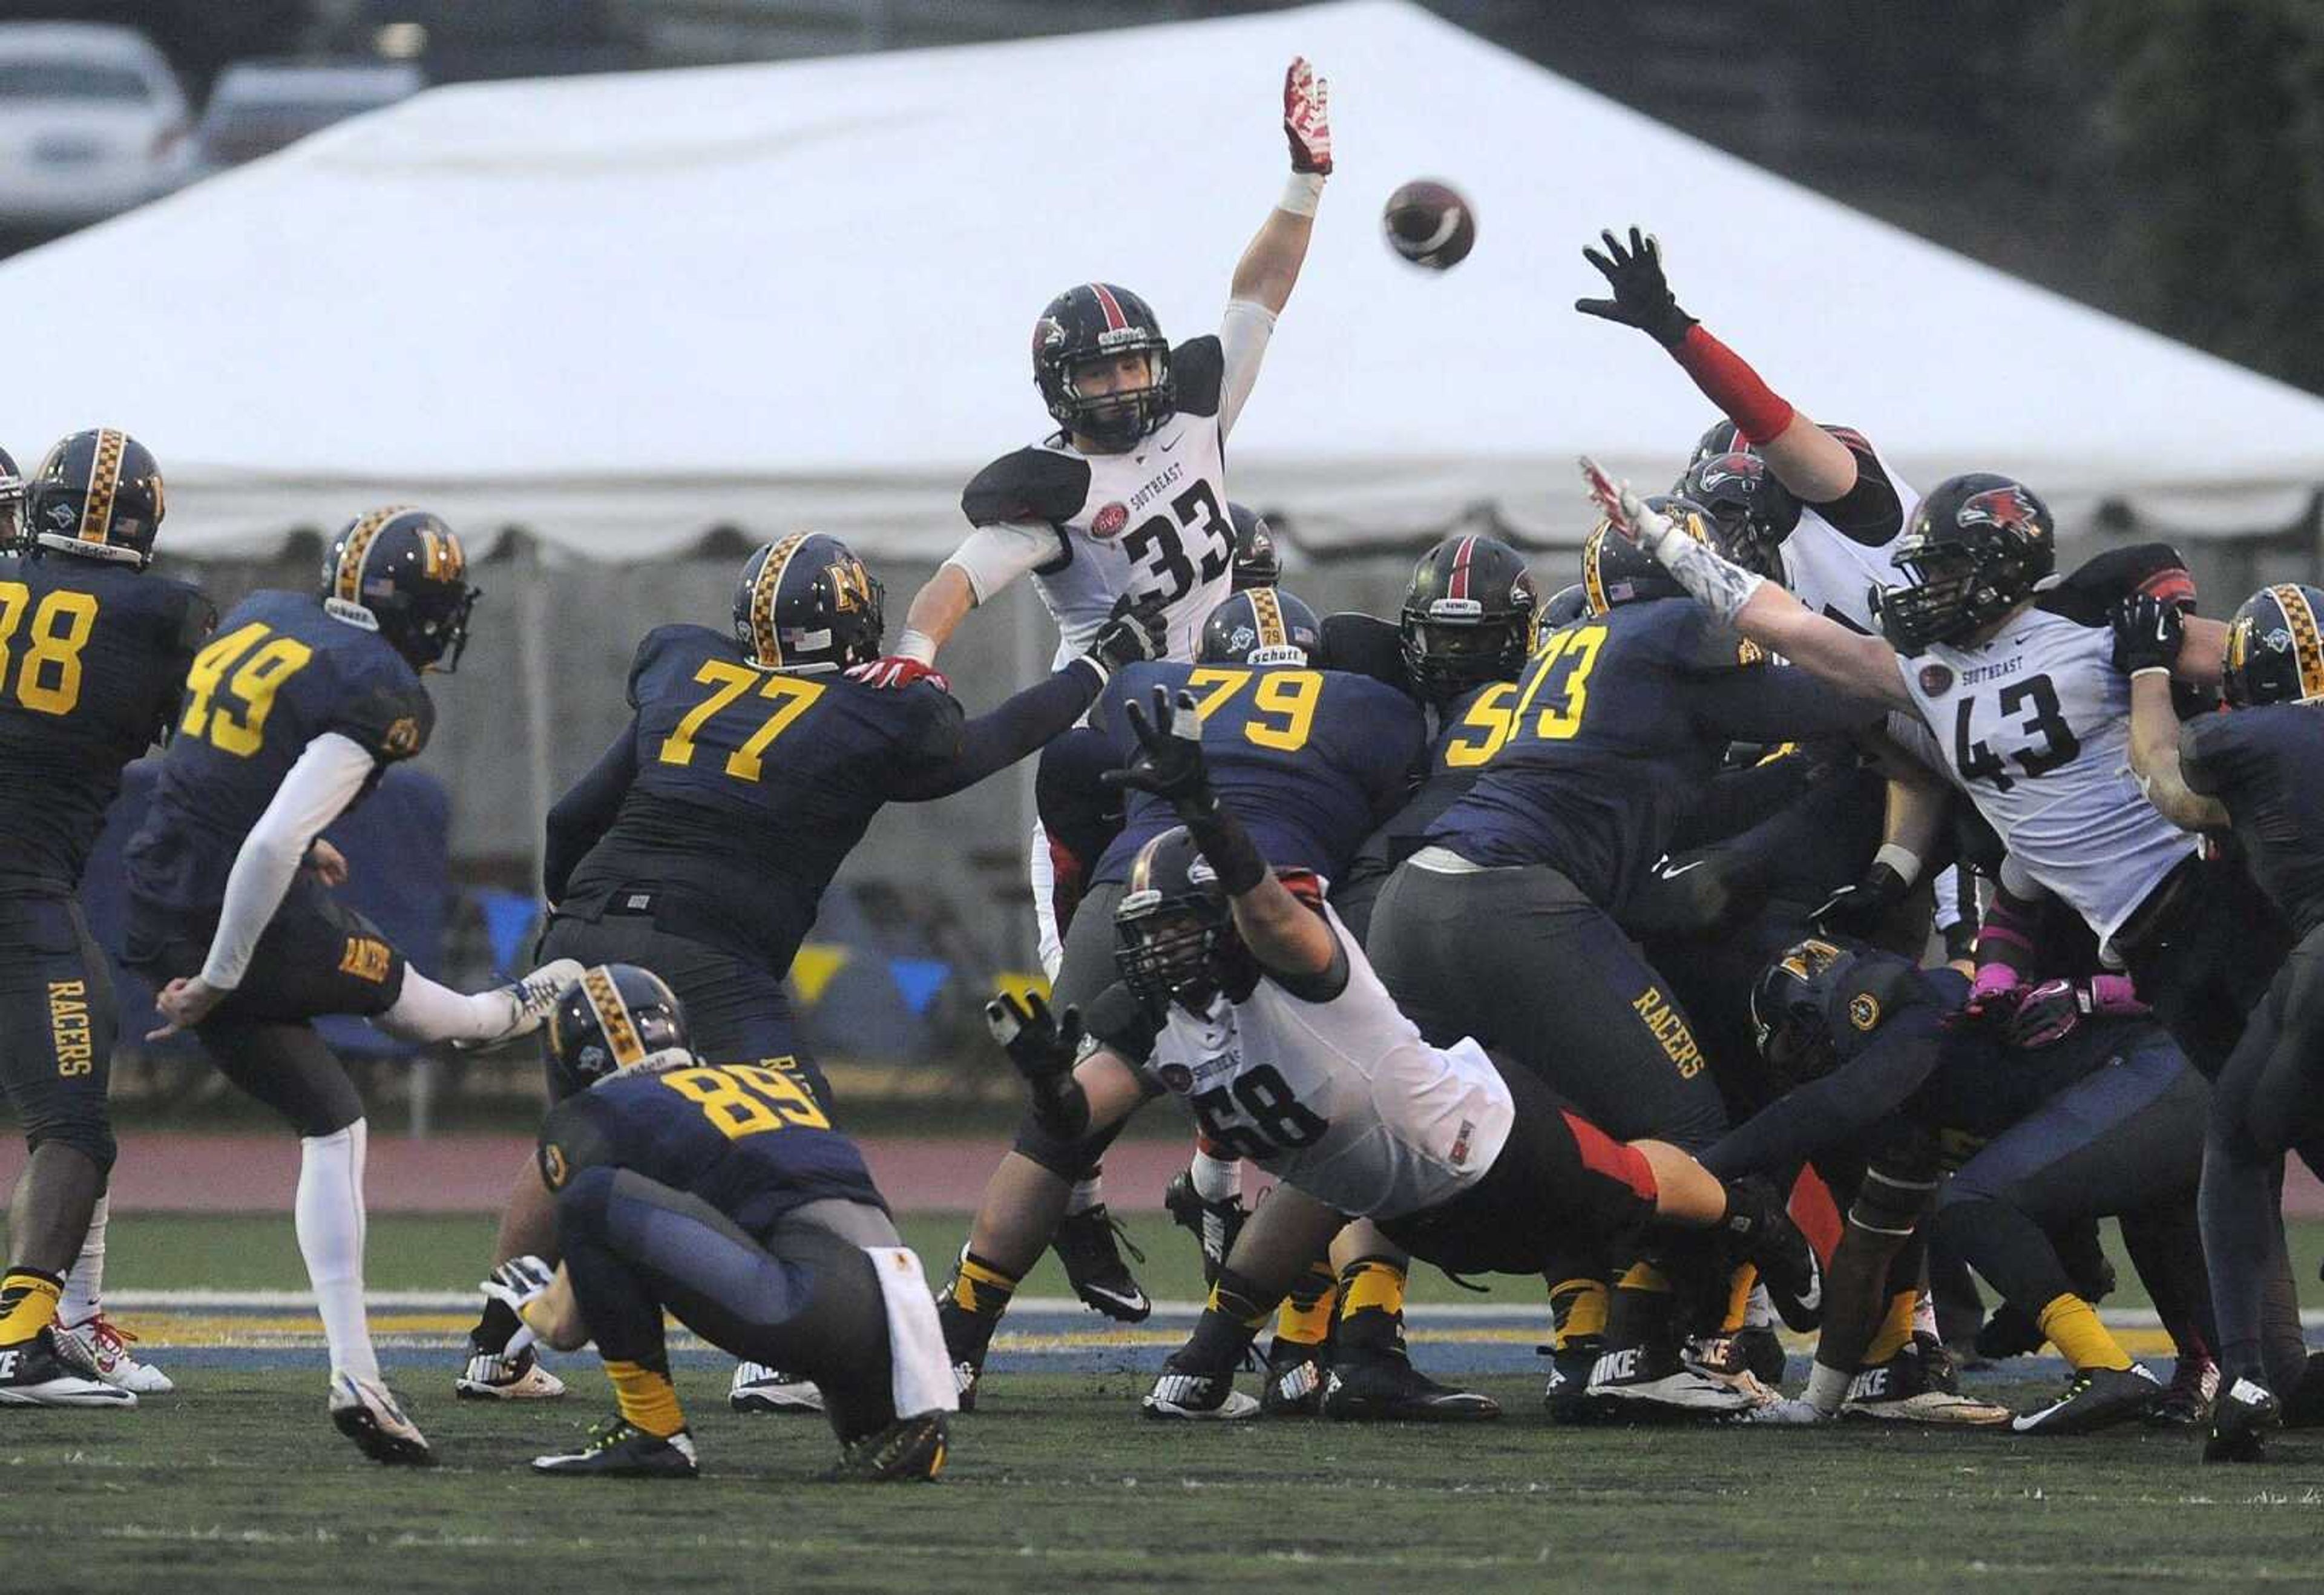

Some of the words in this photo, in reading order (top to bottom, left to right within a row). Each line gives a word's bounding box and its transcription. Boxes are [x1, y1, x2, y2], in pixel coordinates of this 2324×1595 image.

[1130, 462, 1184, 511] SOUTHEAST
[1121, 478, 1236, 610] 33
[182, 622, 313, 757] 49
[1187, 668, 1324, 752] 79
[1506, 626, 1609, 743] 73
[1962, 656, 2023, 686] SOUTHEAST
[660, 659, 827, 782] 77
[1955, 673, 2081, 793] 43
[48, 979, 92, 1077] RACERS
[1632, 986, 1705, 1080] RACERS
[660, 1063, 832, 1140] 89
